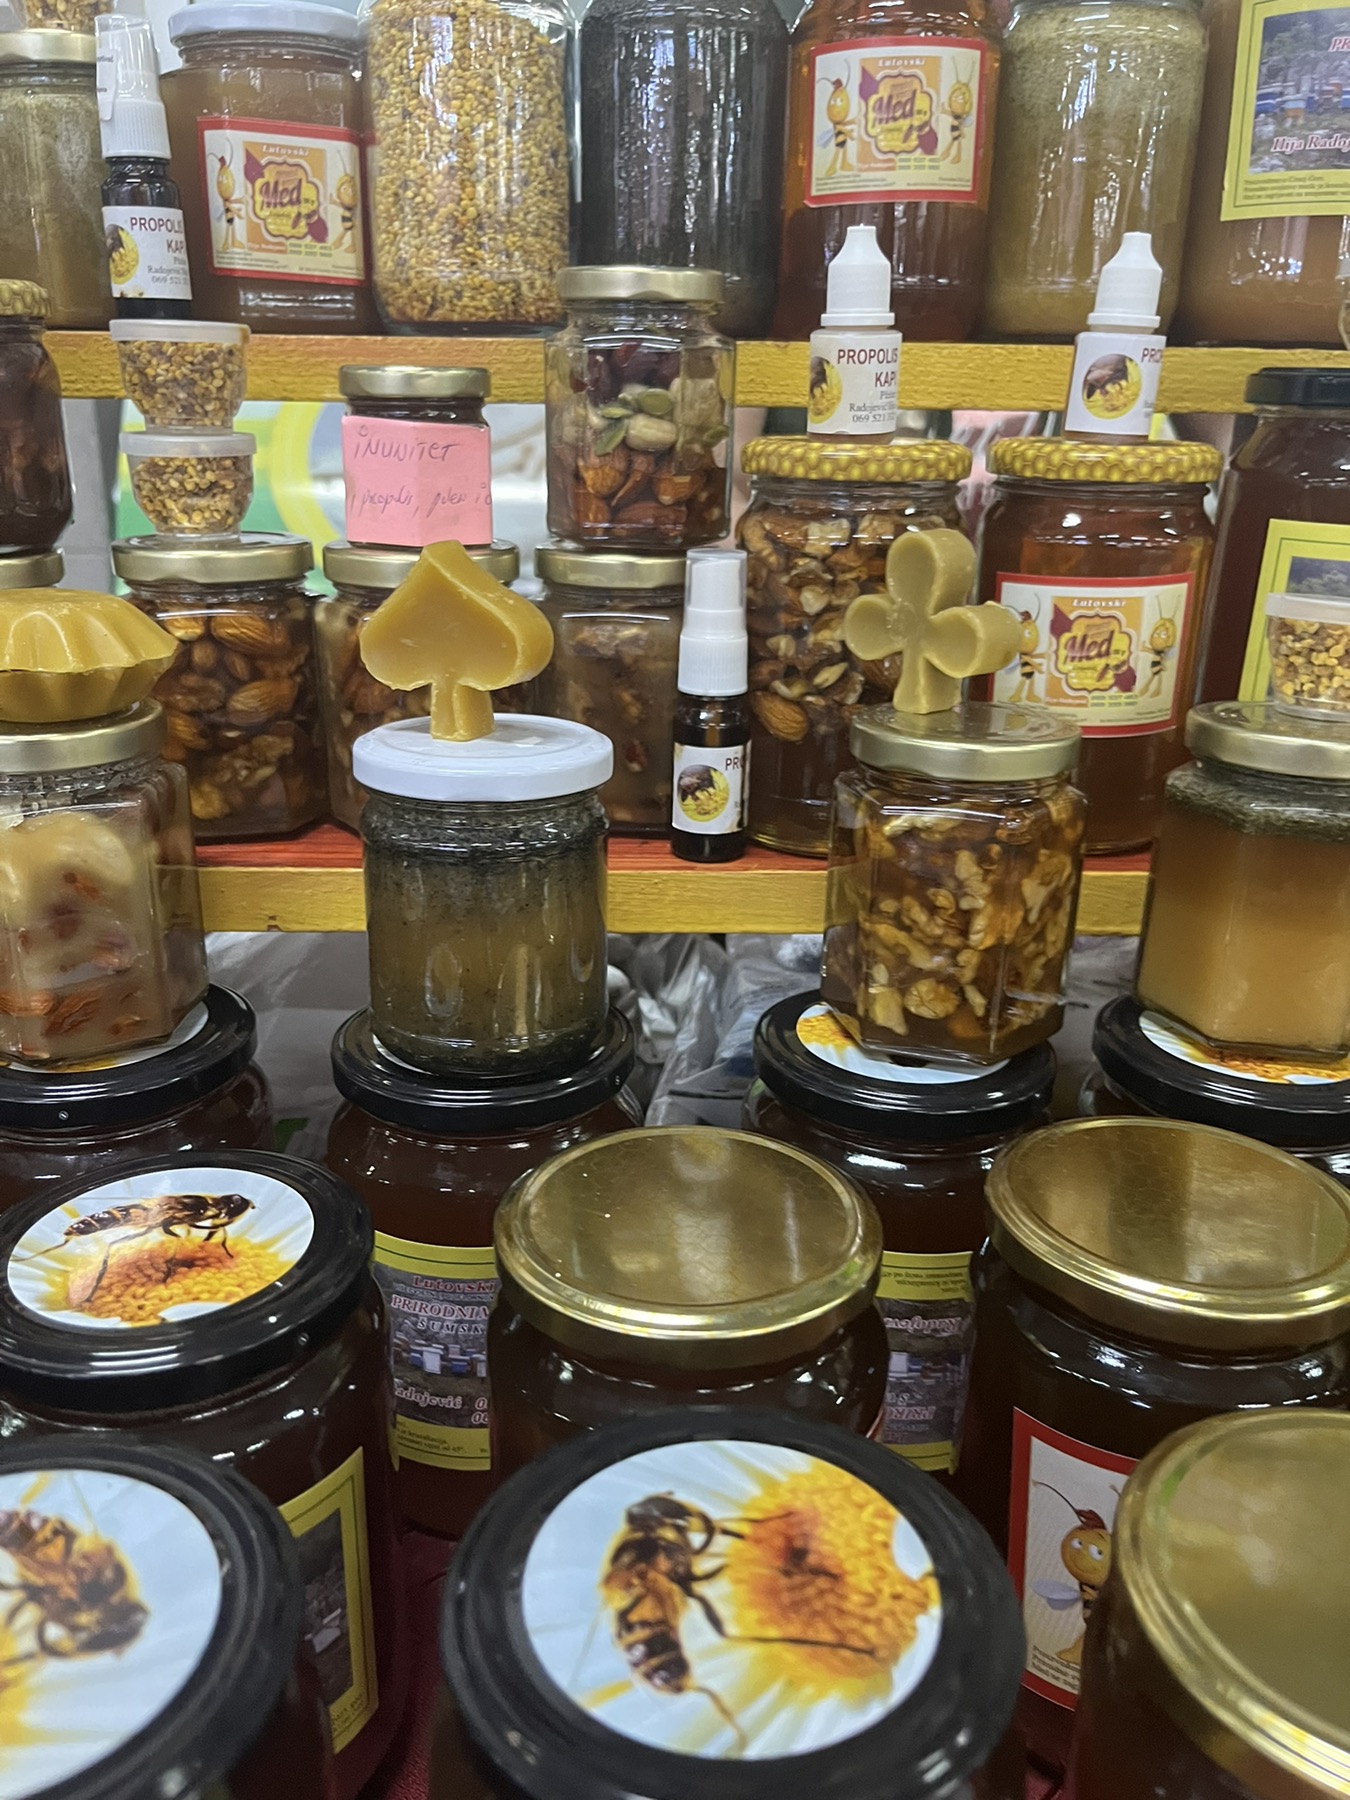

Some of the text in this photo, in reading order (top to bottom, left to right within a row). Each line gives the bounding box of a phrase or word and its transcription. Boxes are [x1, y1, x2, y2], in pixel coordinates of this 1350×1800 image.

[871, 89, 918, 129] Med
[260, 178, 303, 212] Med
[1063, 629, 1115, 665] Med
[413, 1275, 496, 1294] Lutovski
[391, 1293, 476, 1320] PRIRODNI
[394, 1386, 463, 1410] adojević
